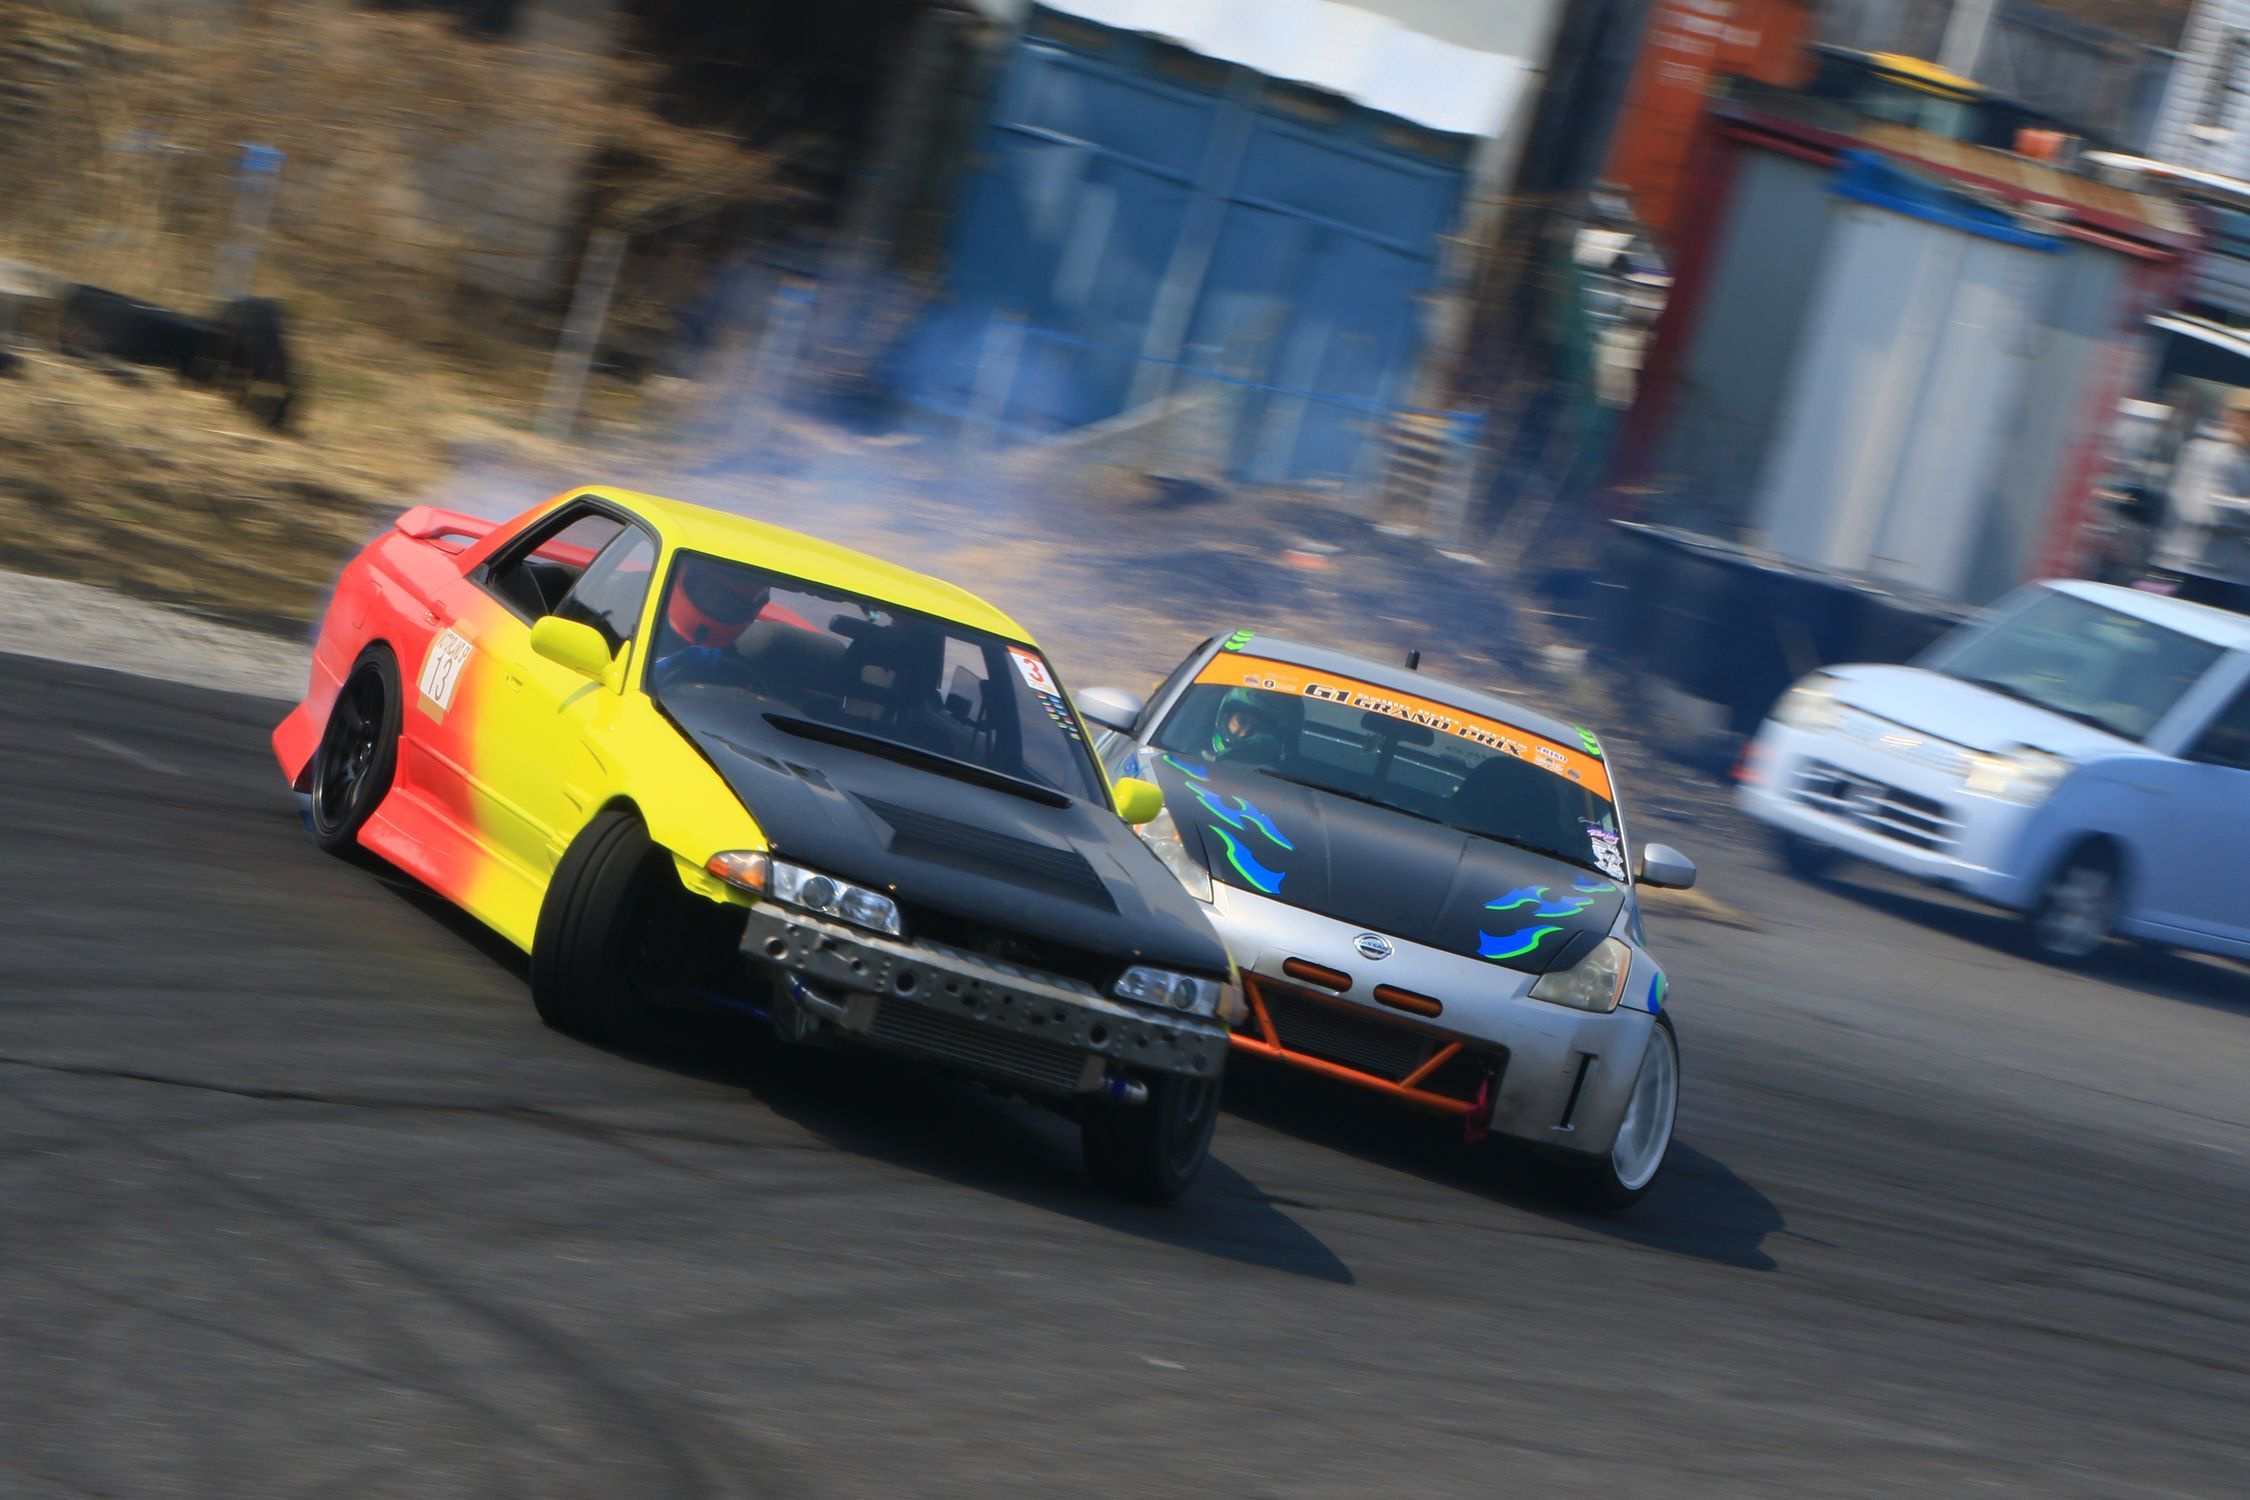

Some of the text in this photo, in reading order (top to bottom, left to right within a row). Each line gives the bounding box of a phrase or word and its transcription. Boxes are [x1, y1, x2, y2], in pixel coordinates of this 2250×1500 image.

[427, 652, 453, 701] 13
[1022, 657, 1045, 683] 3
[1353, 698, 1451, 731] GRAND
[1457, 727, 1527, 758] PRIX
